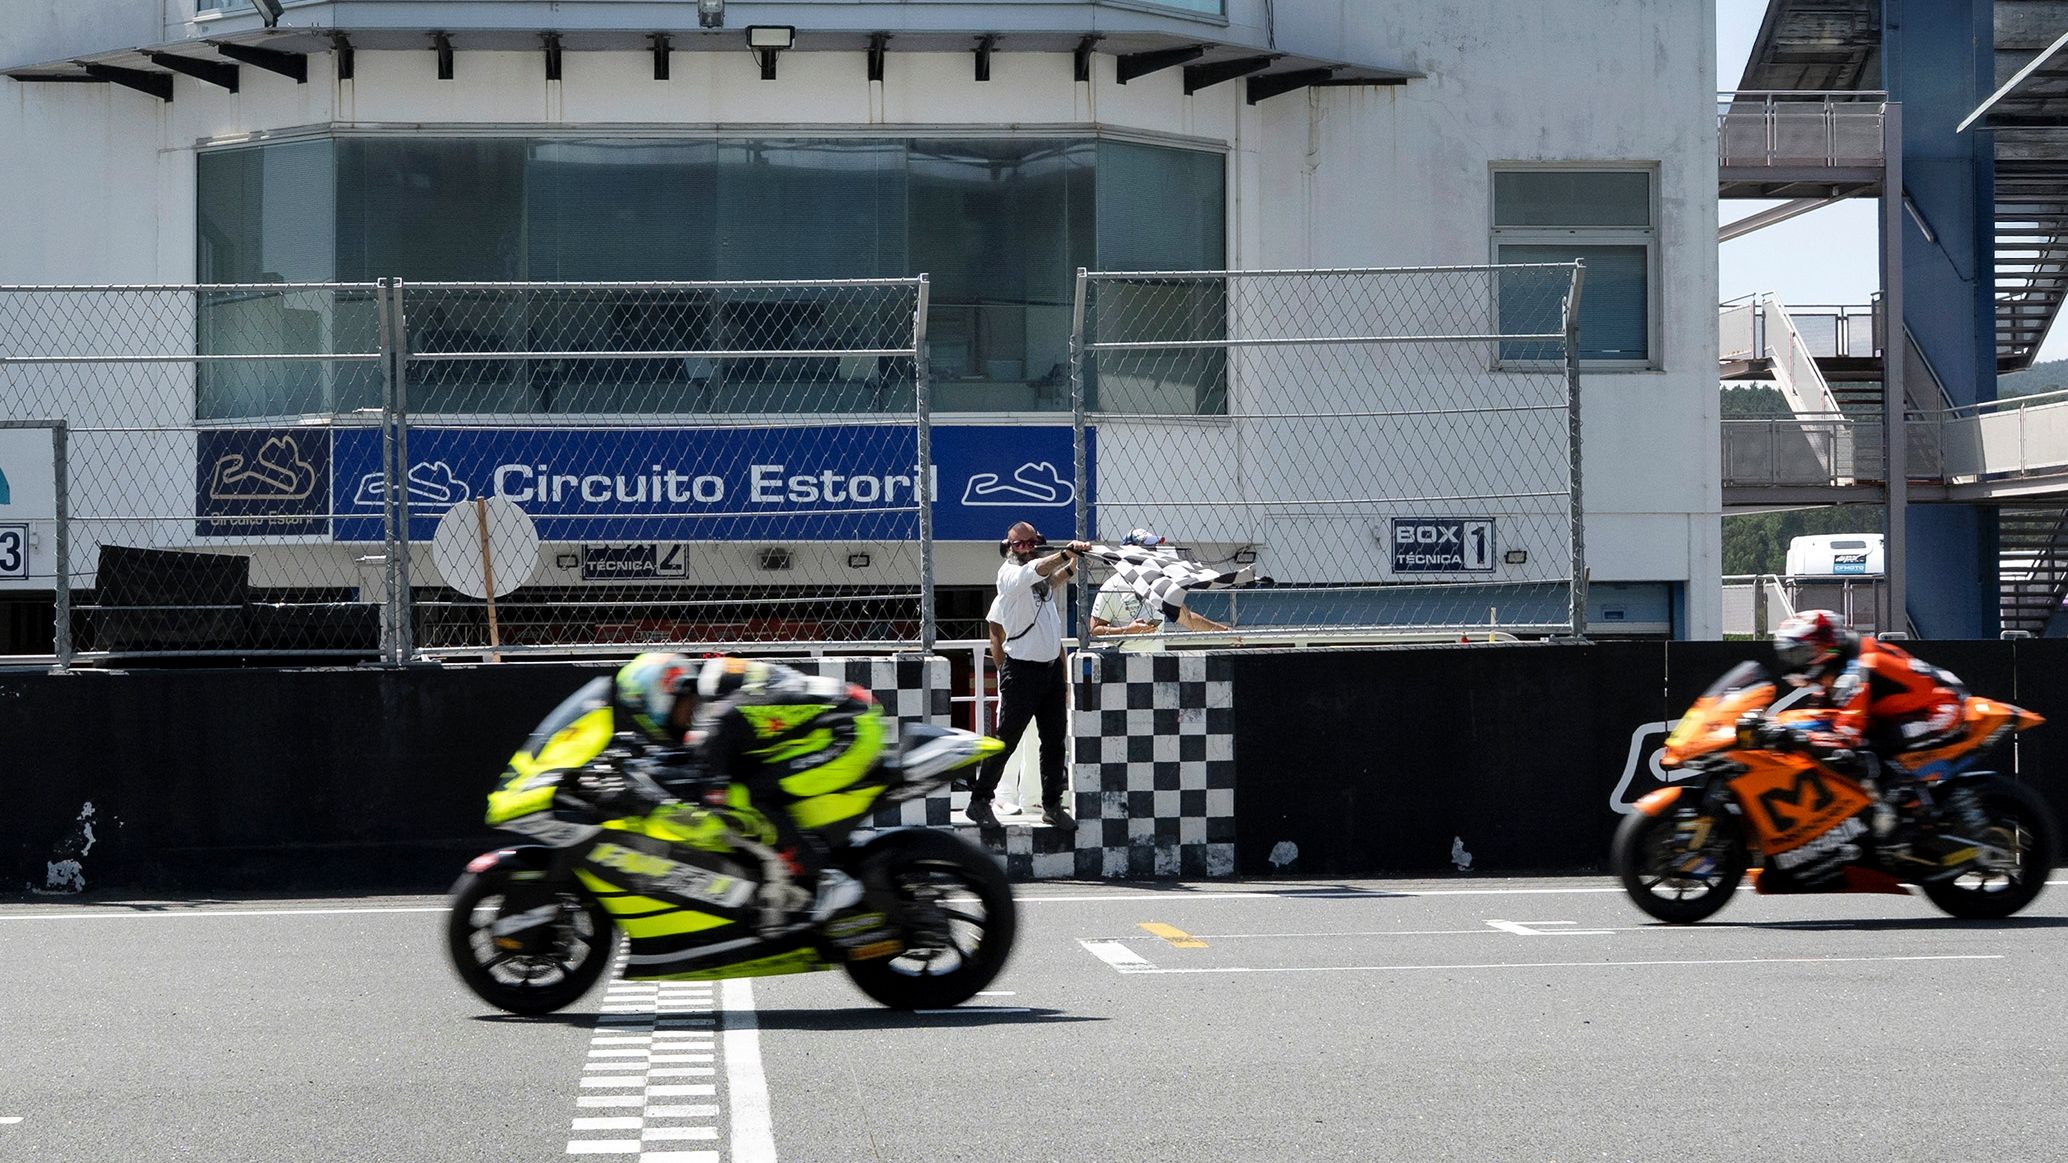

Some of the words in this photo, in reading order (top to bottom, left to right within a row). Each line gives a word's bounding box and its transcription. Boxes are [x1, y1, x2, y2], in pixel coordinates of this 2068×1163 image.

[493, 464, 725, 503] Circuito
[750, 464, 938, 503] Estoril
[0, 531, 22, 572] 3
[1396, 526, 1460, 543] BOX
[1471, 526, 1485, 564] 1
[1396, 551, 1462, 564] TÉCNICA
